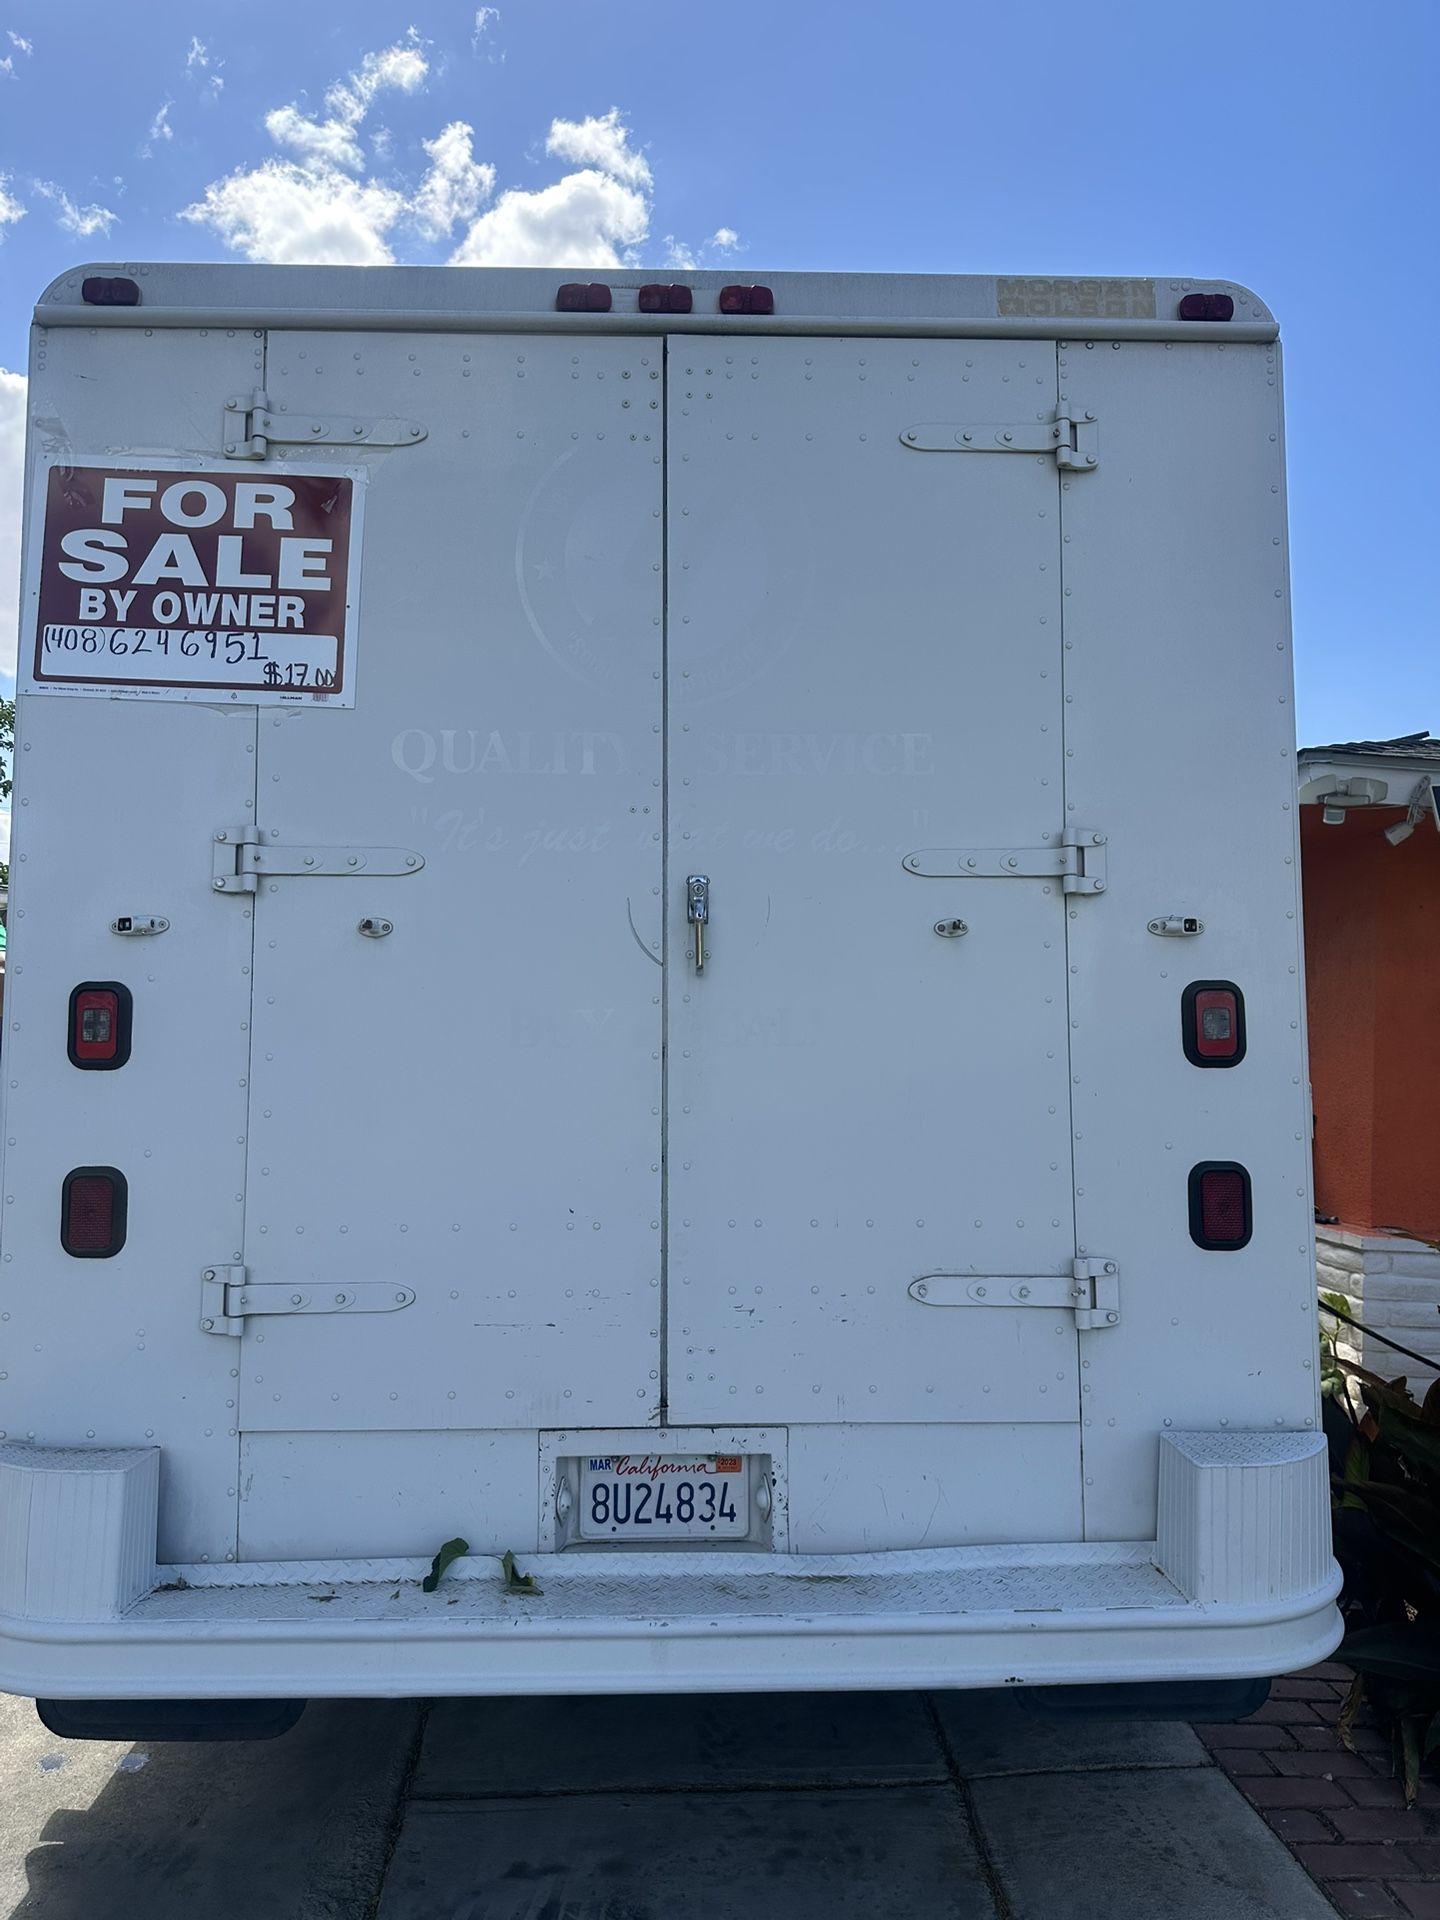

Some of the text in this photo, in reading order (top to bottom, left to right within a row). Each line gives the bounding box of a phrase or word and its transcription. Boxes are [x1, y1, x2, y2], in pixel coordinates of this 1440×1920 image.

[101, 477, 296, 530] FOR
[58, 528, 334, 591] SALE
[78, 588, 306, 629] BY OWNER
[698, 731, 935, 778] SERVICE
[517, 819, 611, 868] just
[741, 824, 797, 853] we
[590, 1456, 737, 1481] MAR California 2023
[591, 1481, 737, 1525] 8U24834
